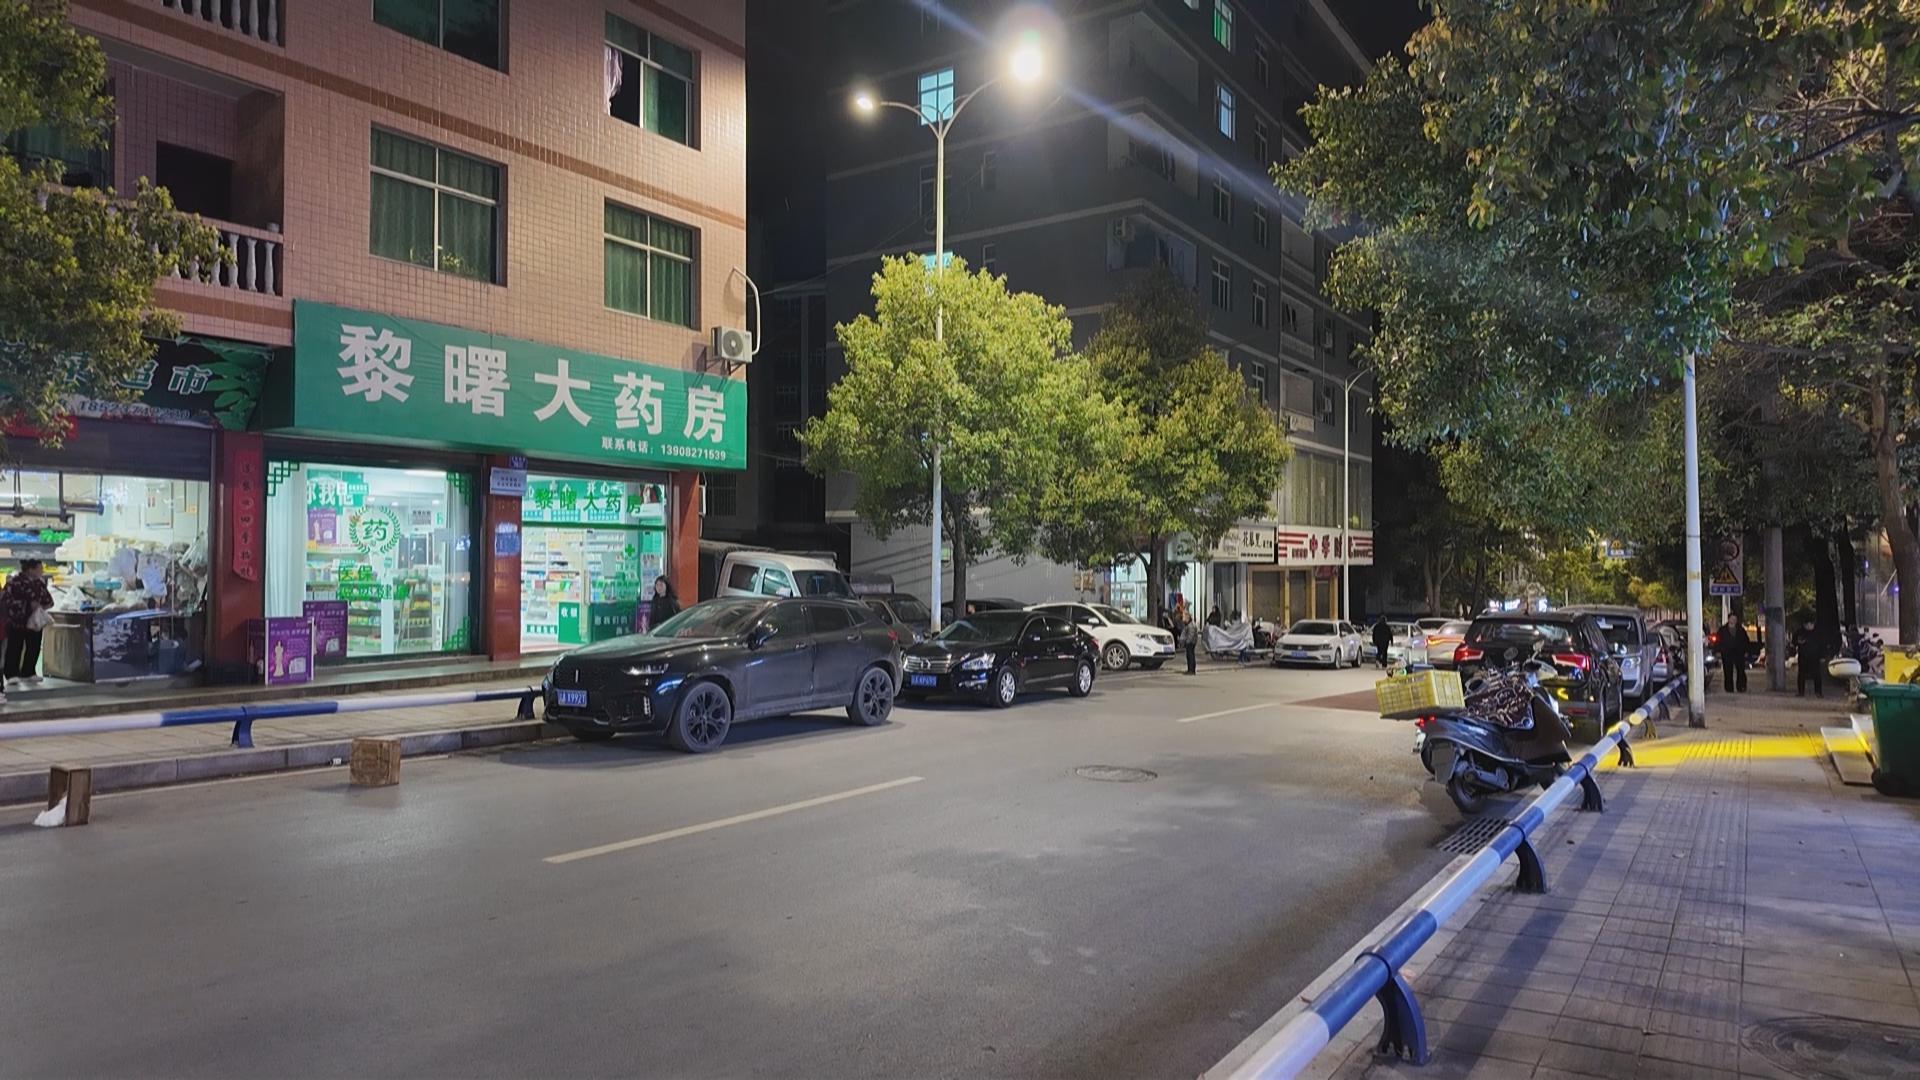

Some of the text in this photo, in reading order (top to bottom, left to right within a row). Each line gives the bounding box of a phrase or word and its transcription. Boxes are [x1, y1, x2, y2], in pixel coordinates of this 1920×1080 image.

[337, 321, 727, 443] 黎曙大药房
[660, 444, 727, 461] 13908271539
[362, 519, 389, 542] 药
